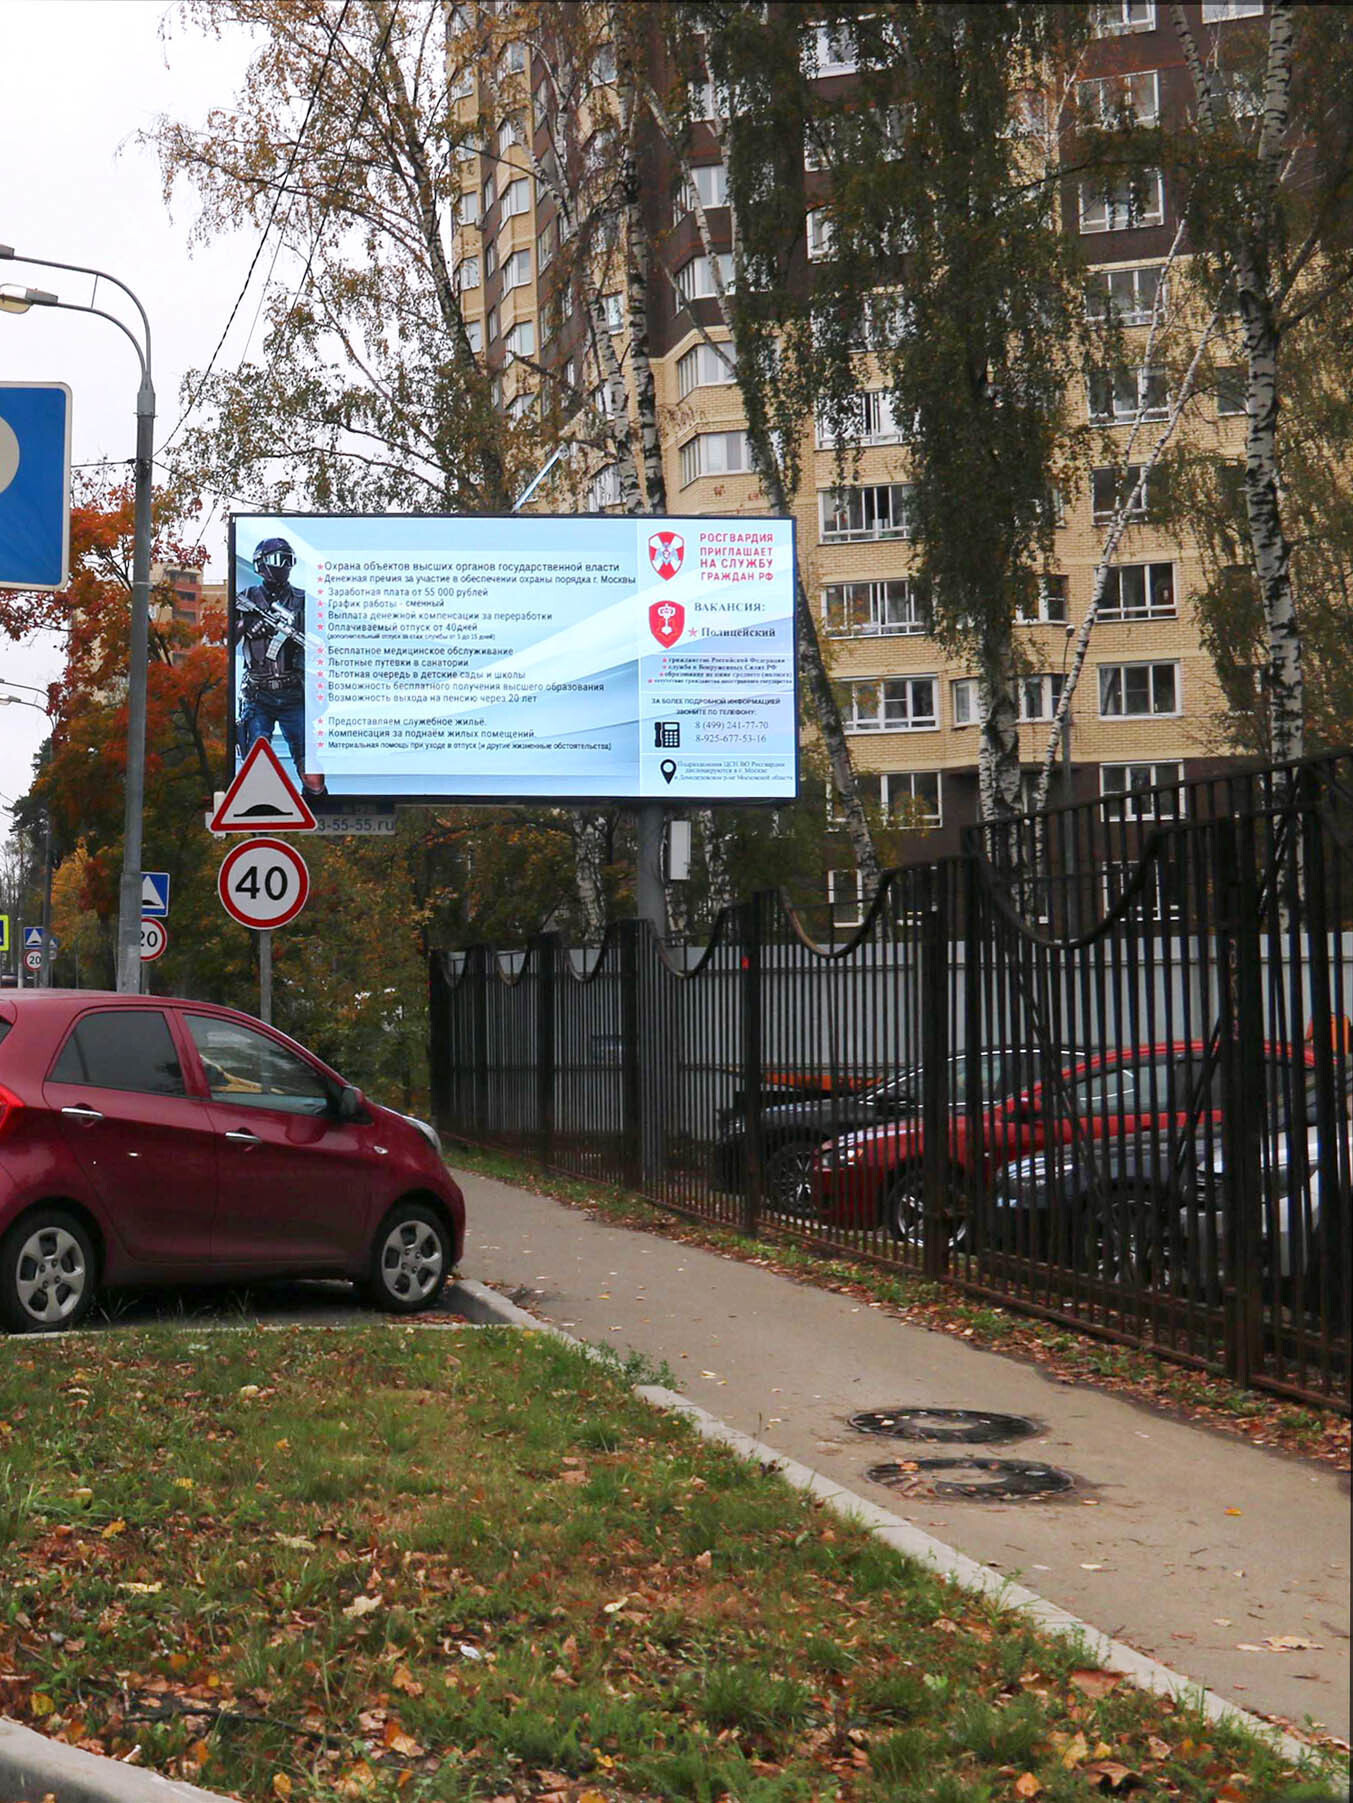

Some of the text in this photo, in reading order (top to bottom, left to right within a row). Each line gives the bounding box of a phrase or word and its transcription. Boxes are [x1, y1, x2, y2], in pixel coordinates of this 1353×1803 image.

[700, 533, 774, 544] РОСГВАРДИЯ
[700, 547, 773, 557] ПРИГЛАШАЕТ
[324, 561, 620, 573] Охрана объектов высших органов государственной власти
[700, 559, 773, 568] НА СЛУЖБУ
[324, 575, 367, 584] Денежная
[370, 576, 402, 584] премия
[416, 575, 450, 584] участие
[460, 575, 517, 583] обеспечении
[519, 576, 553, 584] охраны
[554, 576, 591, 585] порядка
[600, 575, 636, 584] Москвы
[700, 572, 774, 582] ГРАЖДАН РФ
[328, 587, 381, 597] Заработная
[424, 587, 435, 596] 55
[437, 587, 454, 597] 000
[456, 587, 488, 597] рублей
[328, 600, 360, 609] График
[363, 600, 397, 608] работы
[405, 599, 445, 607] сменный
[694, 603, 766, 612] ВАКАНСИЯ:
[328, 611, 368, 620] Выплата
[370, 612, 417, 620] денежной
[494, 611, 553, 621] переработки
[328, 623, 398, 632] Оплачиваемый
[400, 624, 430, 633] отпуск
[701, 627, 776, 637] Полицейский
[328, 647, 381, 656] Бесплатное
[447, 646, 514, 656] обслуживание
[328, 658, 372, 667] Льготные
[421, 660, 469, 669] санатории
[328, 670, 370, 678] Льготная
[372, 672, 410, 680] очередь
[328, 682, 391, 690] Возможность
[393, 682, 450, 690] бесплатного
[452, 683, 500, 692] получения
[546, 682, 604, 692] образования
[328, 694, 391, 702] Возможность
[393, 695, 427, 703] выхода
[480, 695, 506, 704] через
[508, 694, 519, 702] 20
[328, 717, 400, 726] Предоставляем
[403, 717, 453, 726] служебное
[702, 721, 725, 730] (499)
[328, 730, 390, 738] Компенсация
[695, 734, 767, 743] 8-925-677-53-16
[316, 819, 394, 832] 3-55-55.ru
[235, 866, 288, 900] 40
[29, 956, 41, 965] 20
